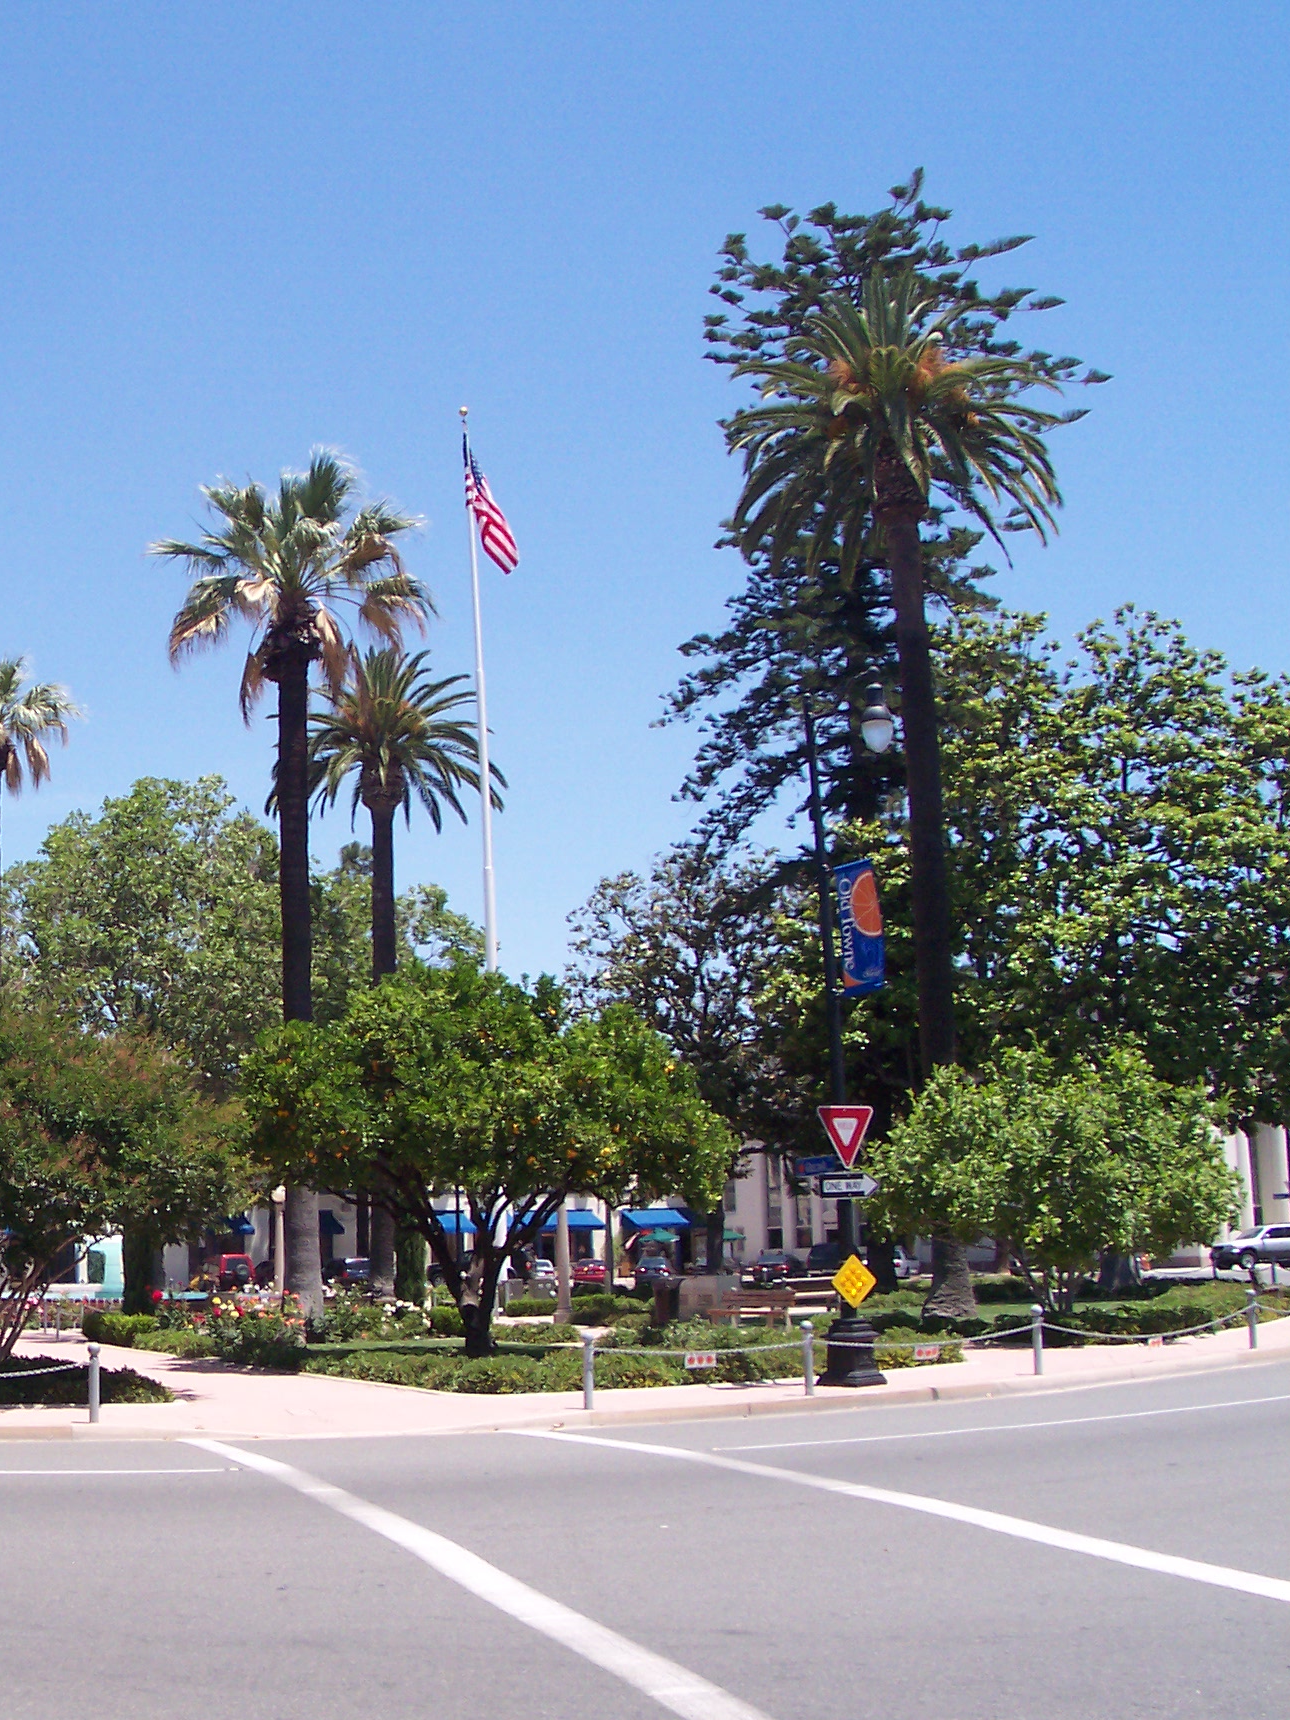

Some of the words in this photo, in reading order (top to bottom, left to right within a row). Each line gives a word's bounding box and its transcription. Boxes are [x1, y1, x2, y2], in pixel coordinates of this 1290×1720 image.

[839, 878, 852, 911] Old
[841, 914, 856, 970] Towne
[825, 1181, 843, 1191] ONE
[845, 1181, 862, 1190] WAY
